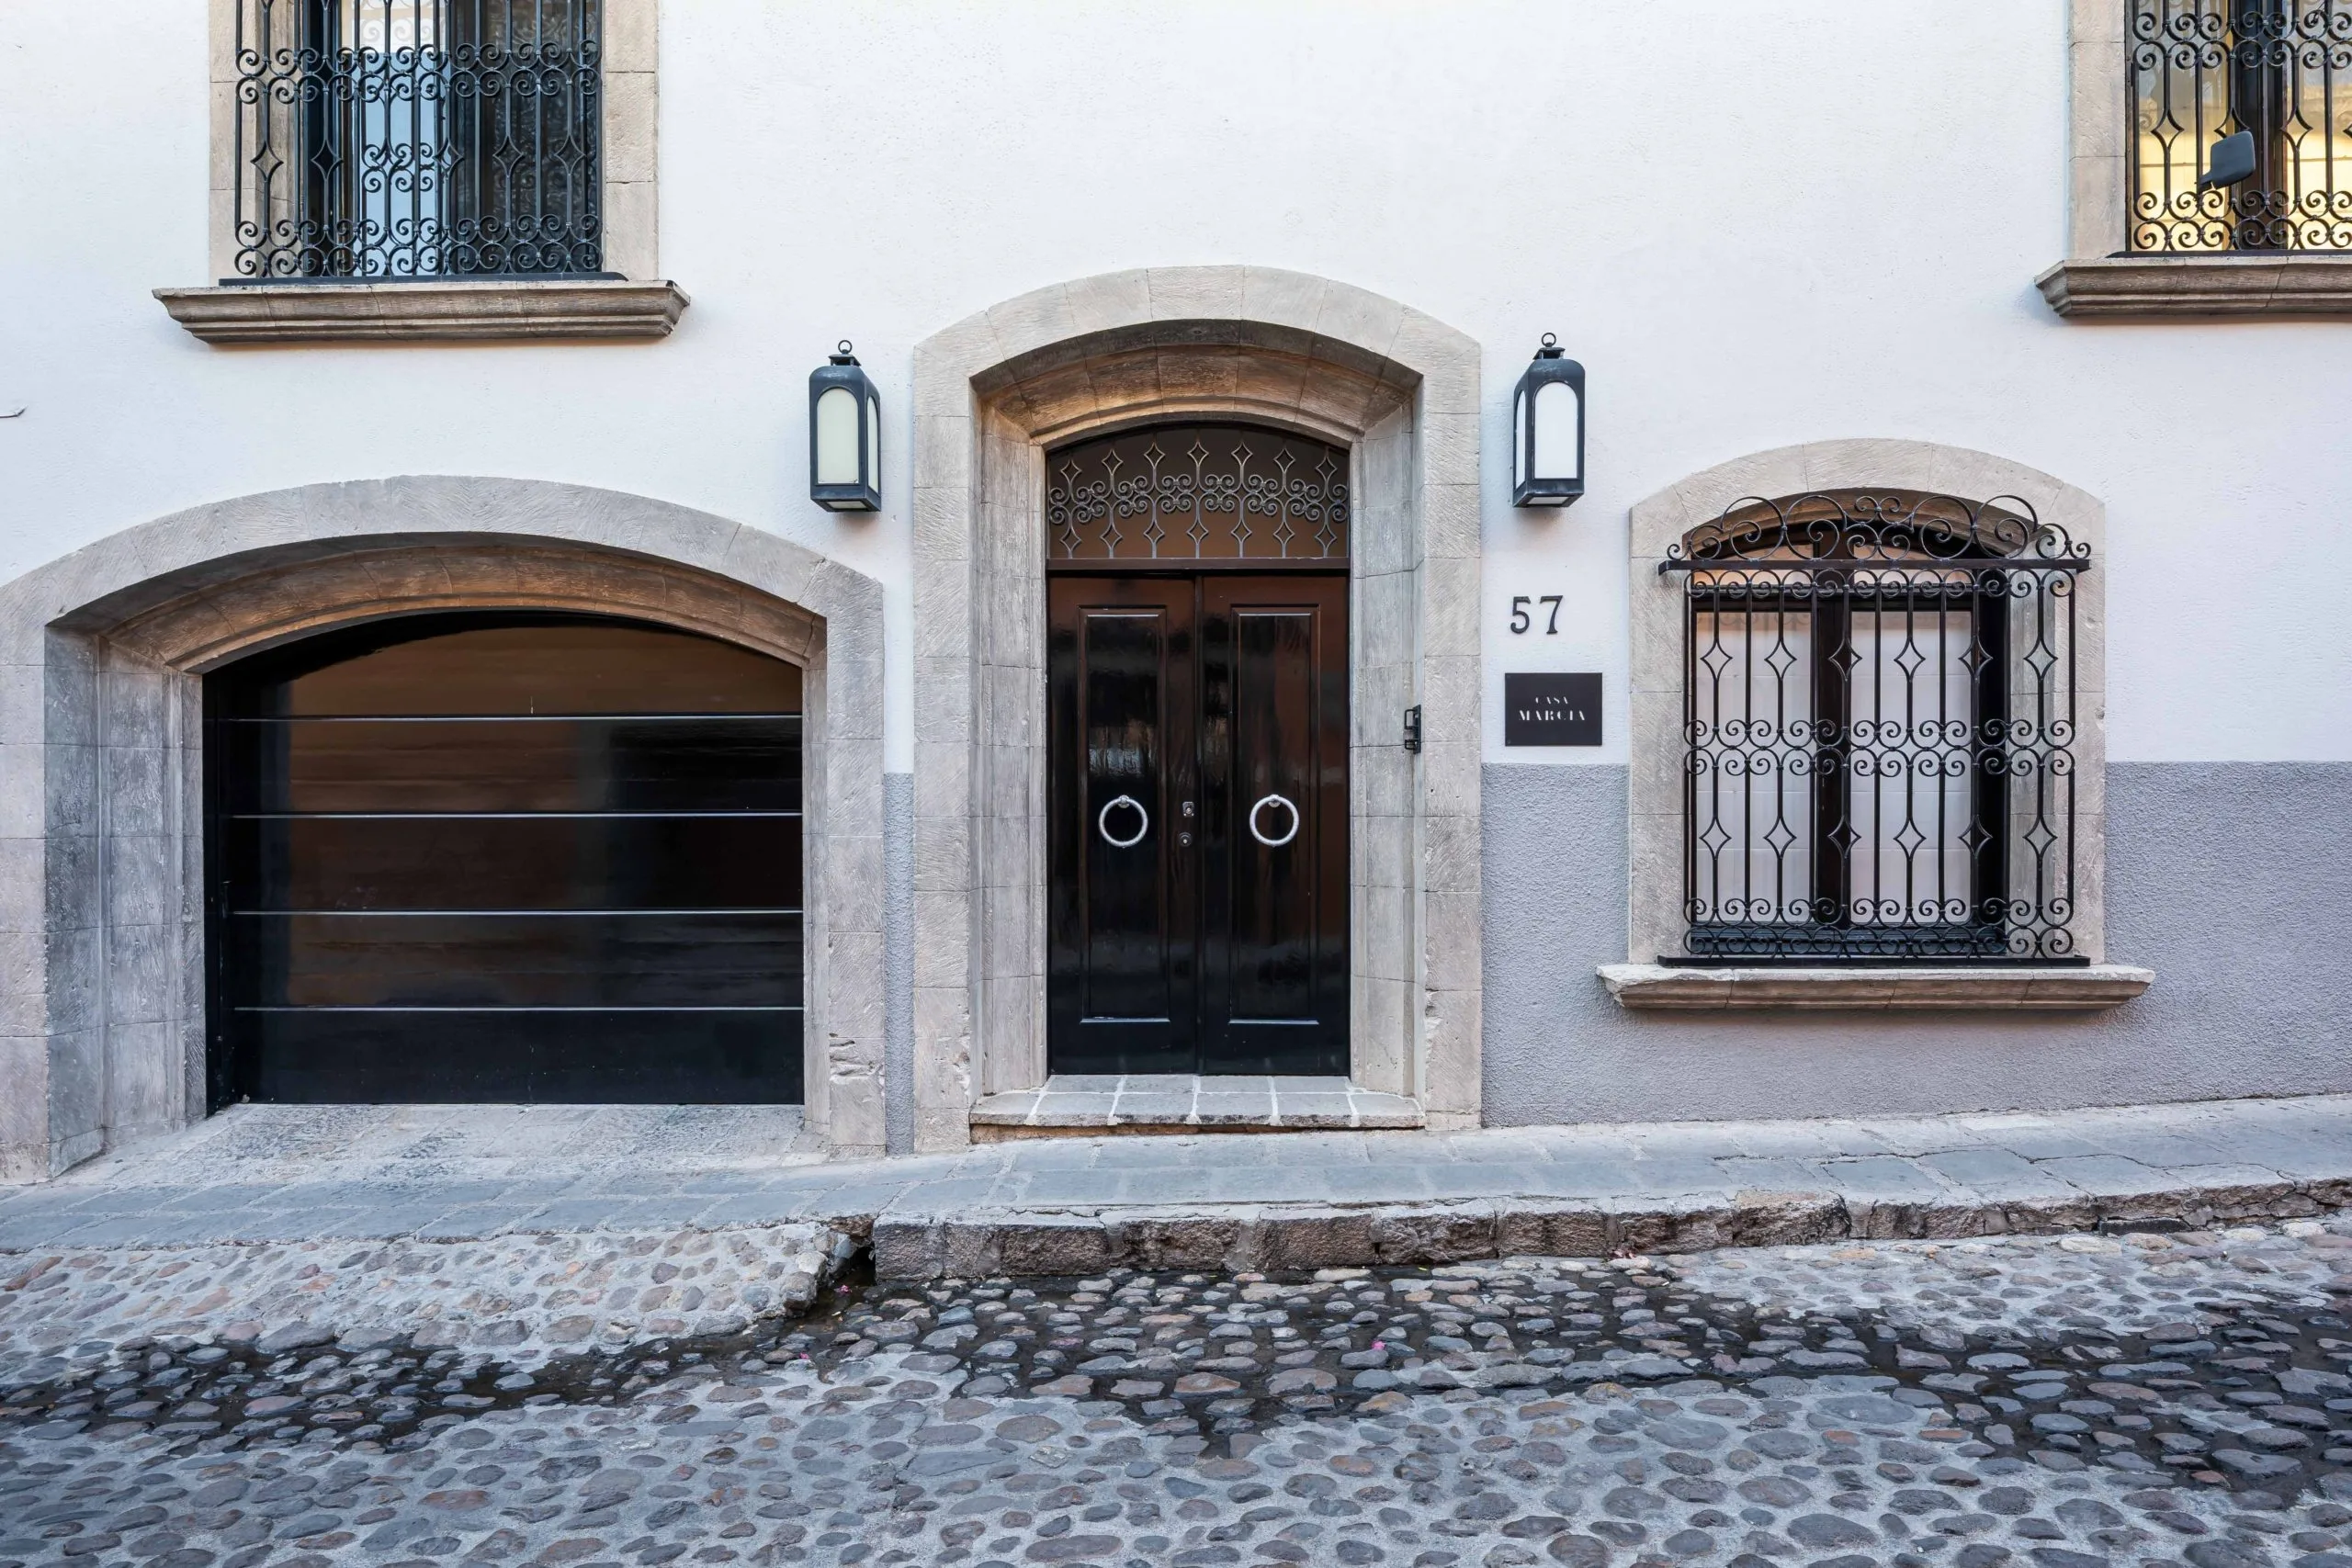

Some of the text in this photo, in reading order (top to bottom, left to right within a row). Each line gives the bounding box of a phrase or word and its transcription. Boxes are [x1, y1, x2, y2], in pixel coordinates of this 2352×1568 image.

[1510, 595, 1564, 635] 57
[1535, 696, 1568, 705] CASA
[1518, 709, 1586, 721] MARCIA
